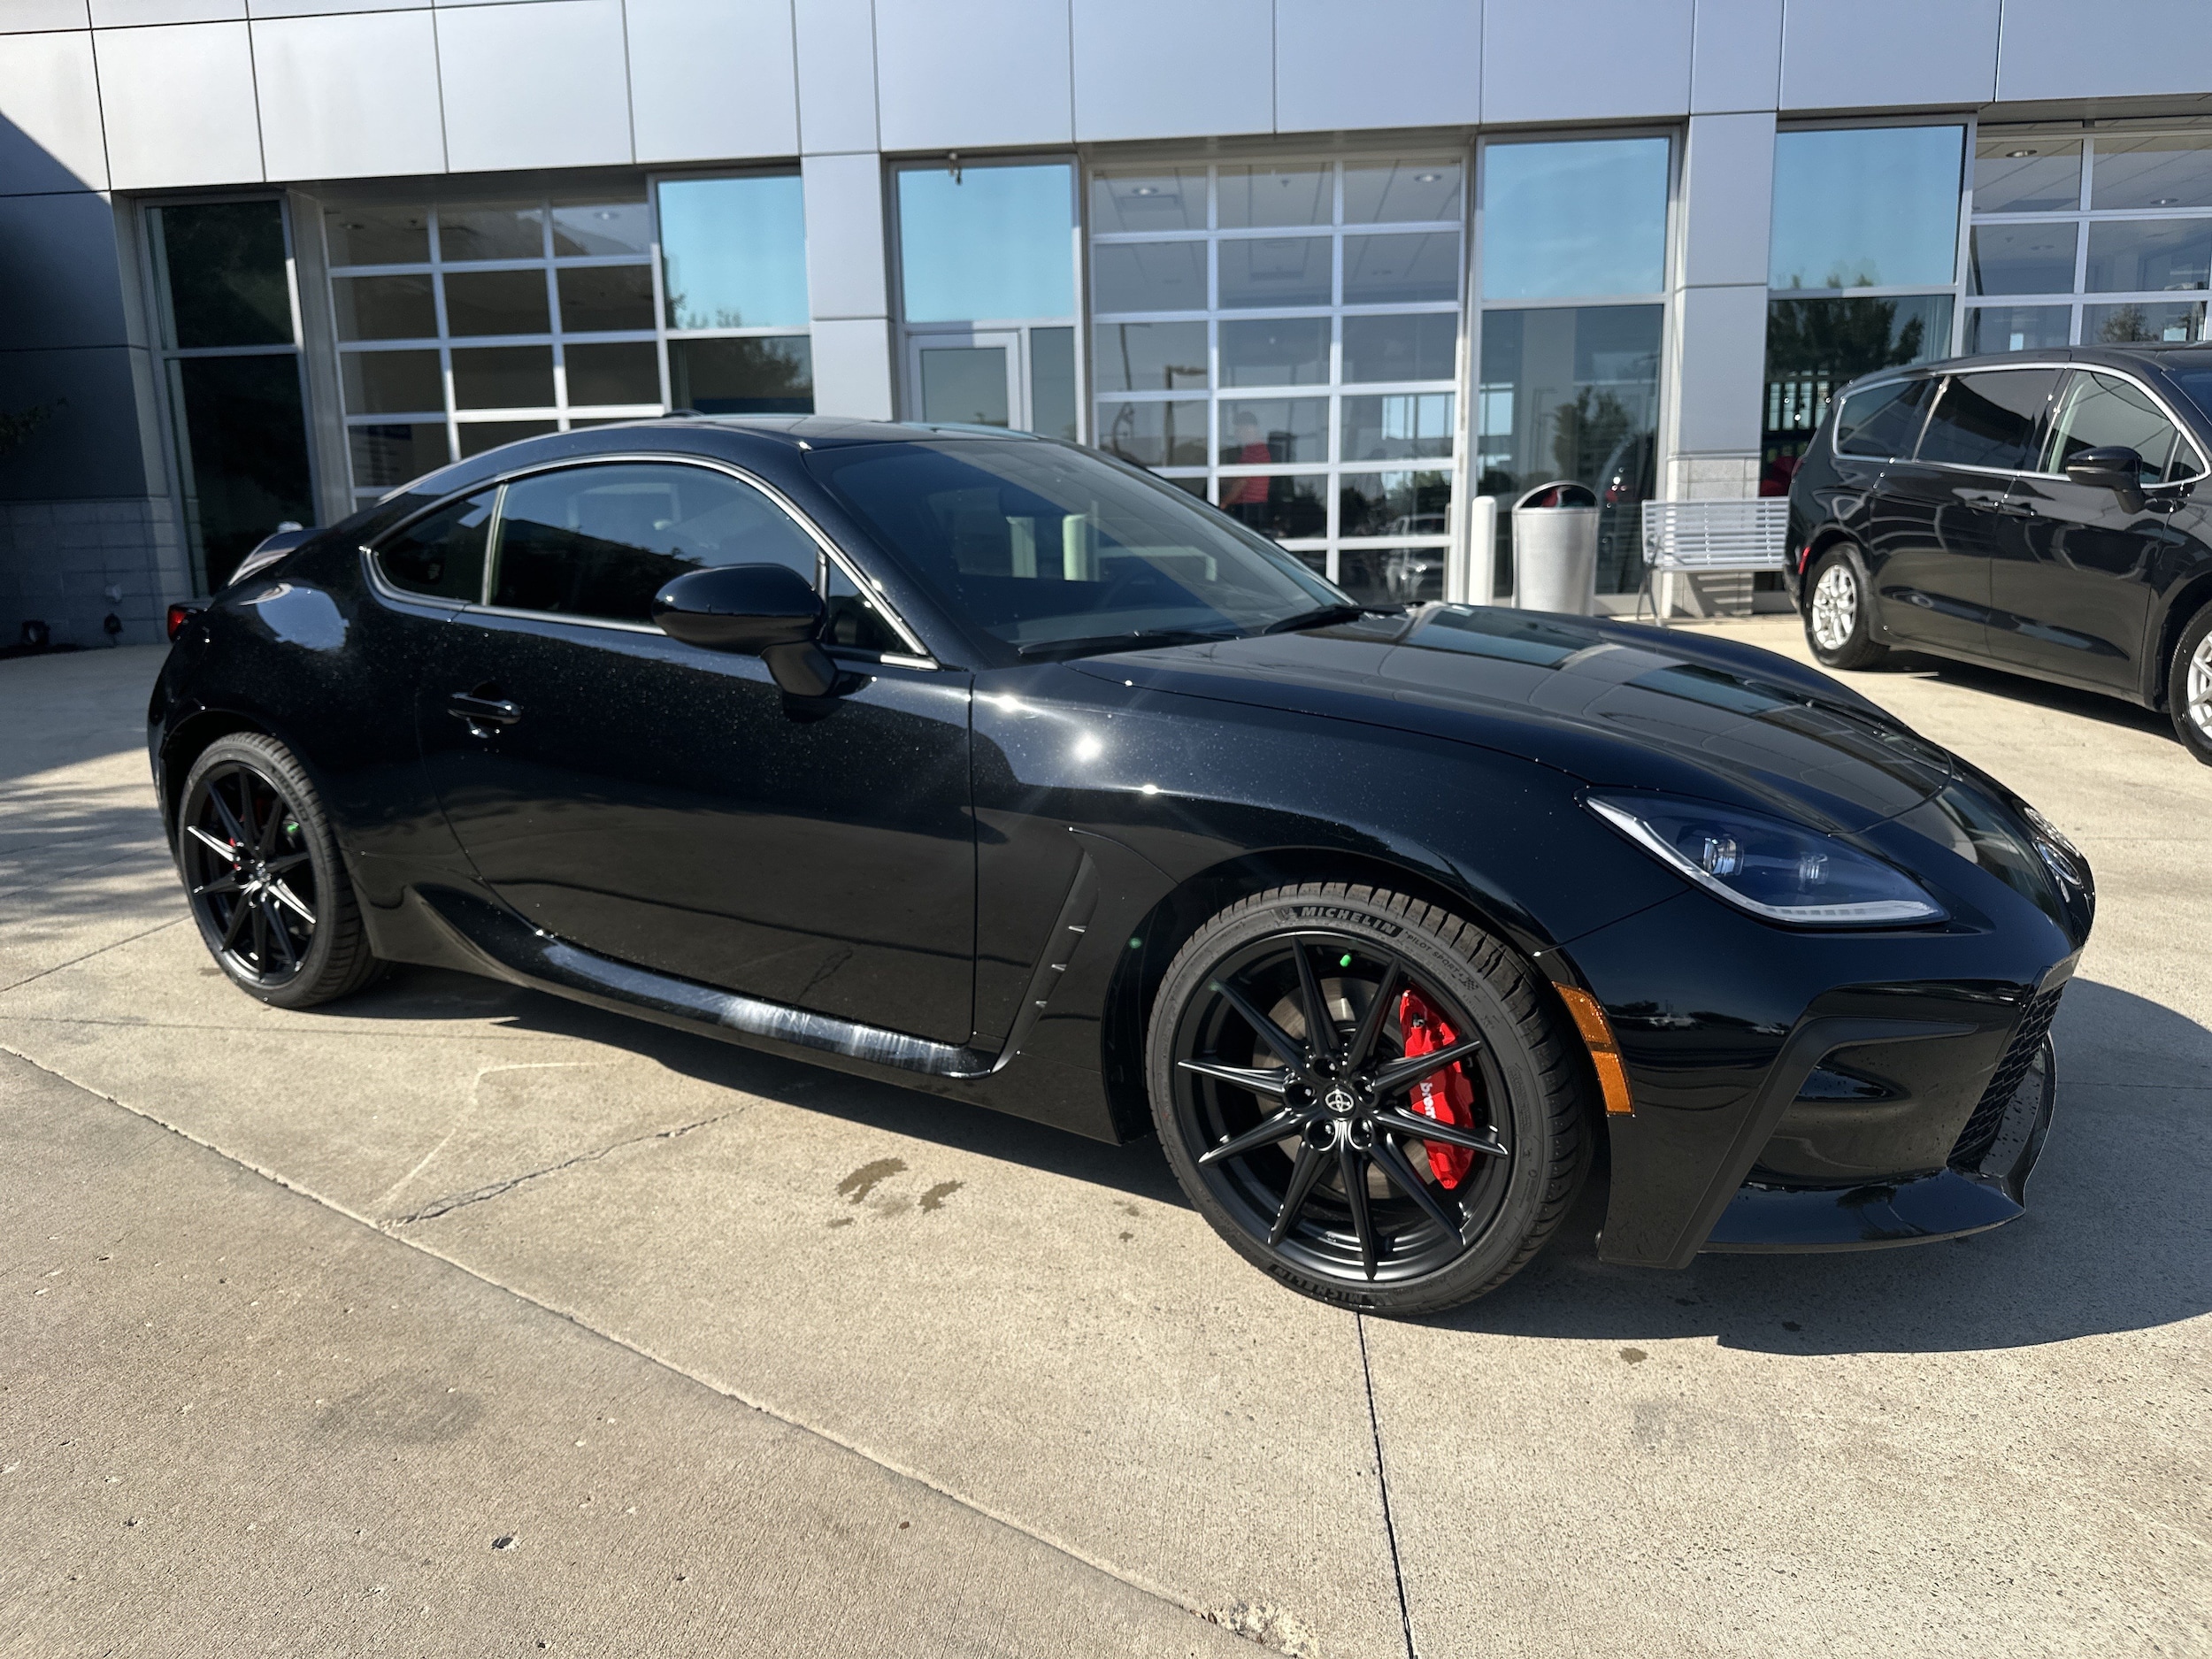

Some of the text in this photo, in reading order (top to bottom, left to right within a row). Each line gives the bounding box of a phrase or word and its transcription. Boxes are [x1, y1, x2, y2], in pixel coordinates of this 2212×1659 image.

[1301, 906, 1396, 935] MICHELIN
[1407, 933, 1432, 952] PILOT
[1432, 951, 1460, 973] SPORT
[1419, 1082, 1437, 1119] brem
[1275, 1265, 1363, 1303] MICHELIN
